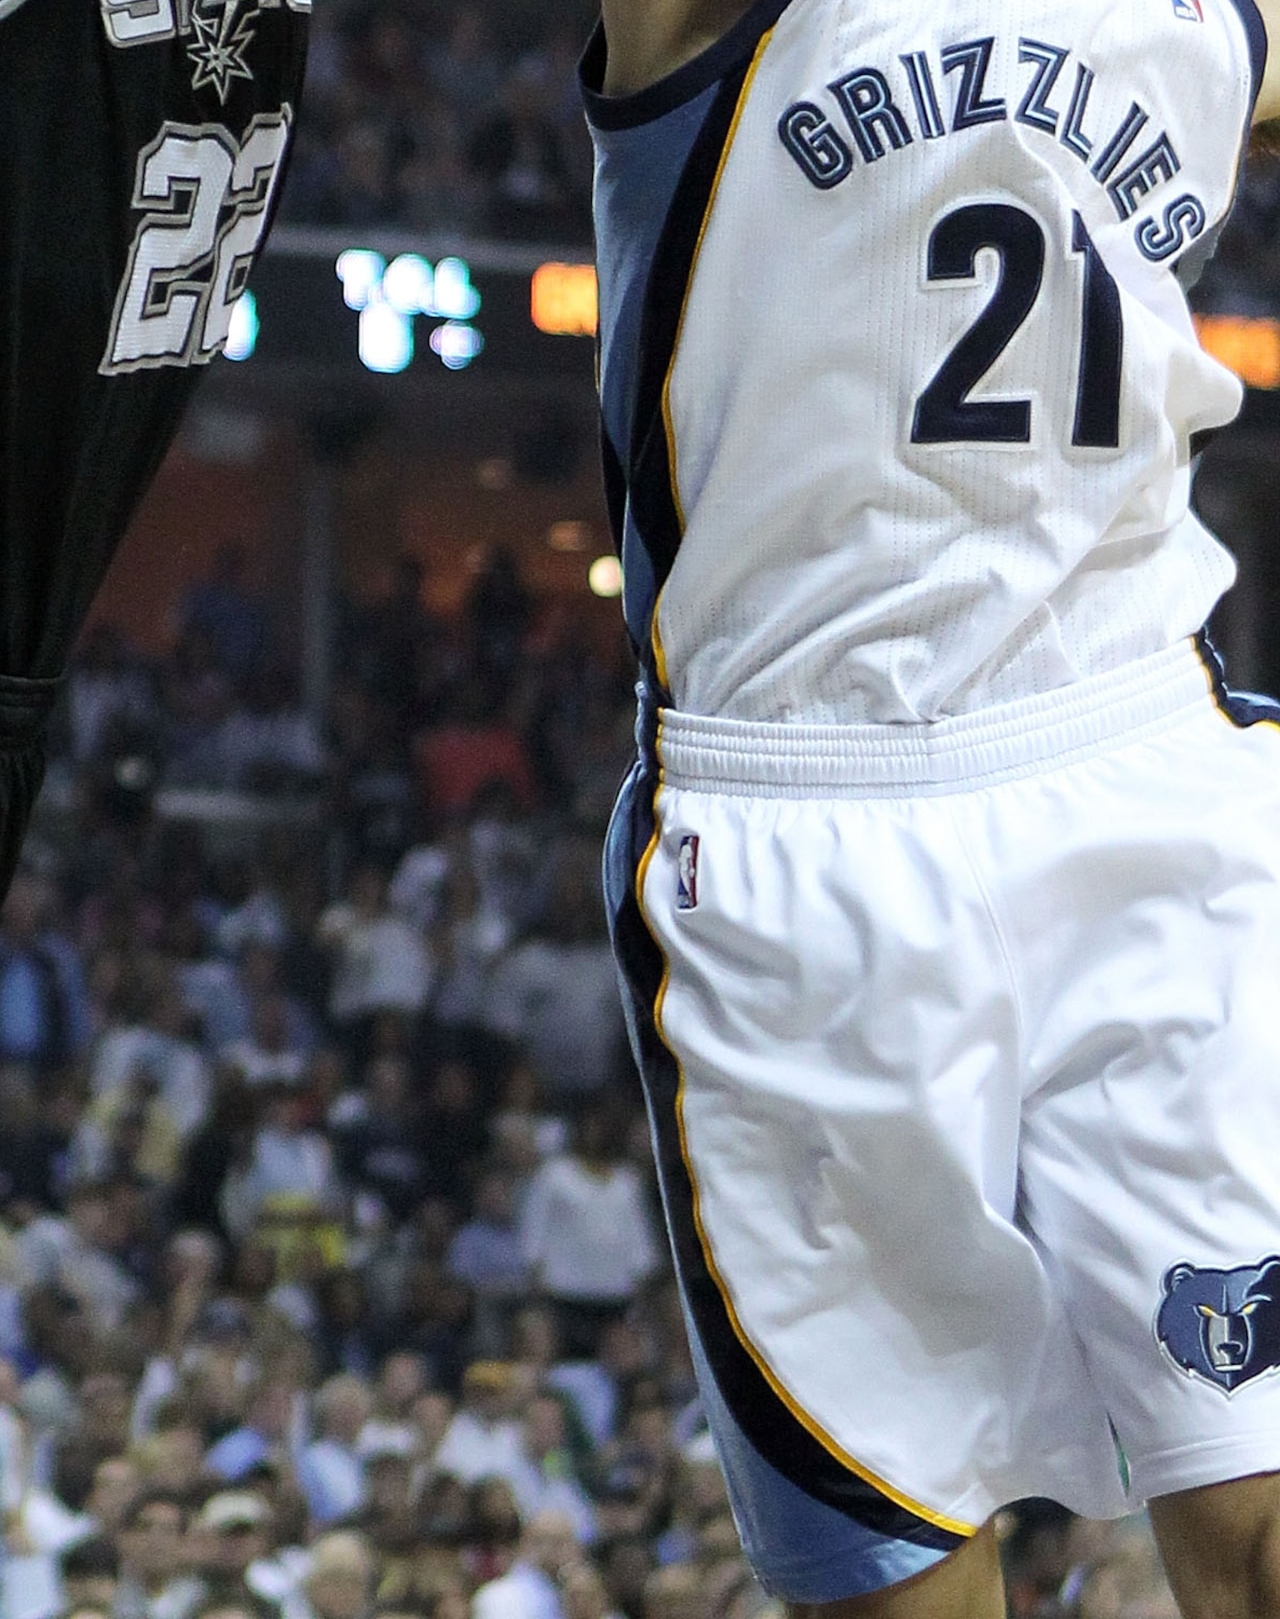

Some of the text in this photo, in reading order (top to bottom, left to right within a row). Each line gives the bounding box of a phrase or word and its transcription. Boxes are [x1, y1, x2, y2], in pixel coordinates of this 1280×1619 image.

[98, 101, 293, 377] 22
[776, 36, 1206, 263] GRIZZLIES
[908, 201, 1122, 449] 21
